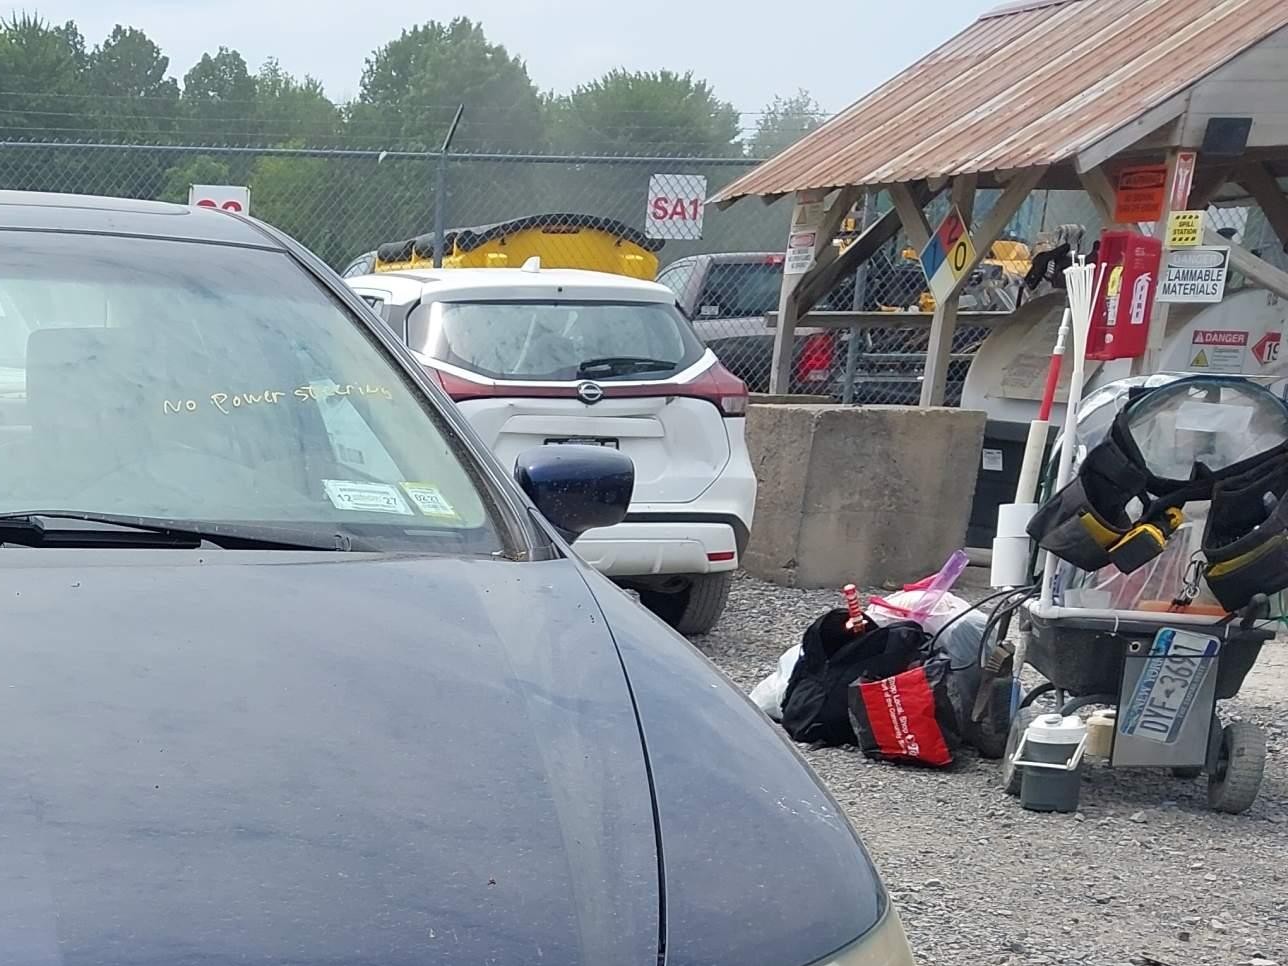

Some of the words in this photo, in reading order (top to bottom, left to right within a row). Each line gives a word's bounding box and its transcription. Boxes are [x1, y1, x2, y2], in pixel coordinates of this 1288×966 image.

[653, 196, 698, 221] SA1
[947, 216, 959, 246] 2
[954, 241, 967, 272] 0
[1167, 270, 1223, 282] LAMMABLE
[1162, 283, 1218, 296] MATERIALS
[1205, 333, 1245, 344] DANGER
[1139, 697, 1177, 733] DYF
